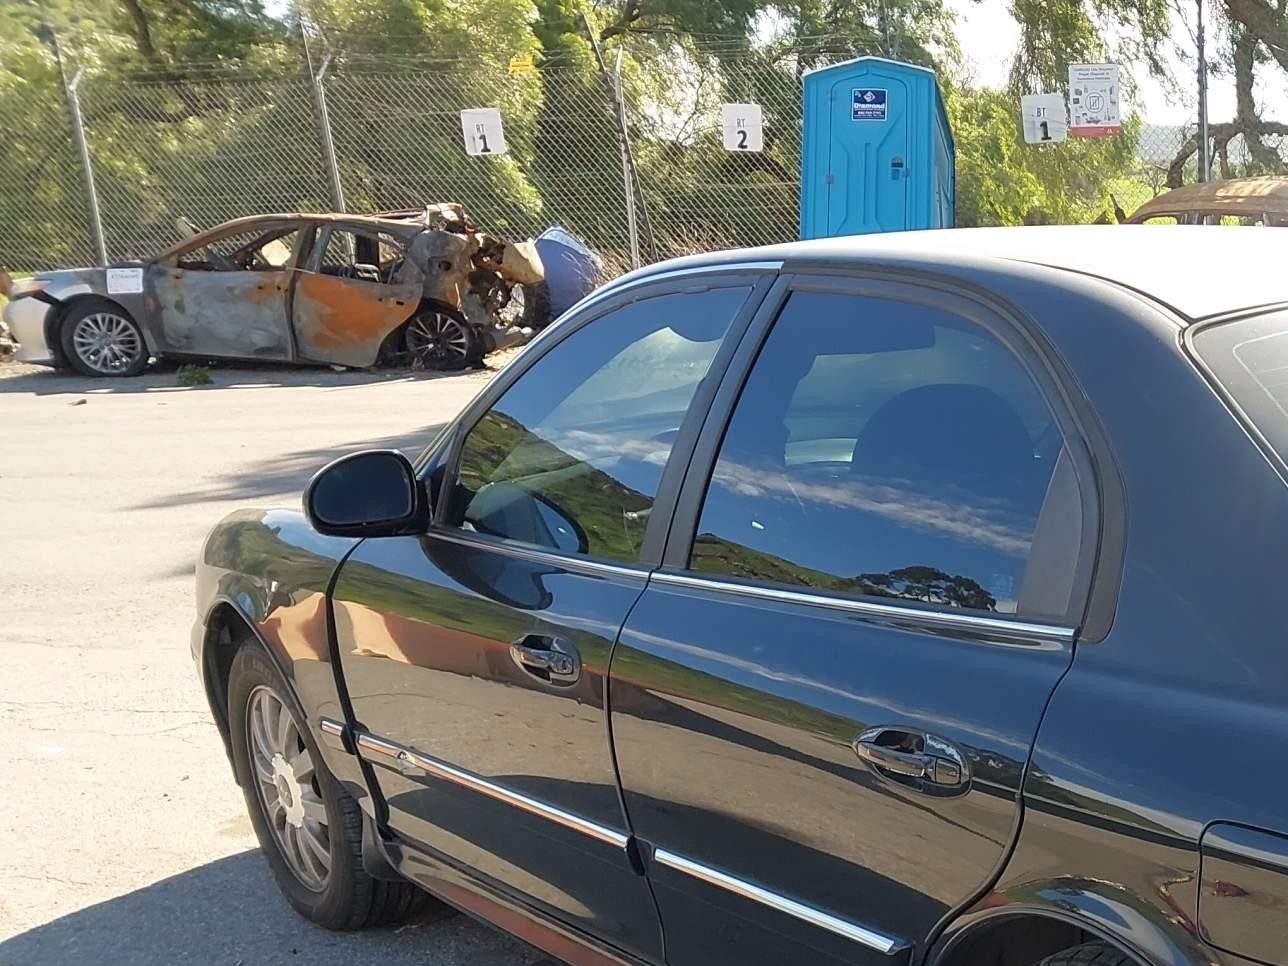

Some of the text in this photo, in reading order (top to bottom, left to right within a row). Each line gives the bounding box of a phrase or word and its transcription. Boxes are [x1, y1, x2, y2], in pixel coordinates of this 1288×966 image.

[736, 129, 749, 149] 2
[1040, 120, 1052, 141] 1
[479, 134, 492, 153] 1
